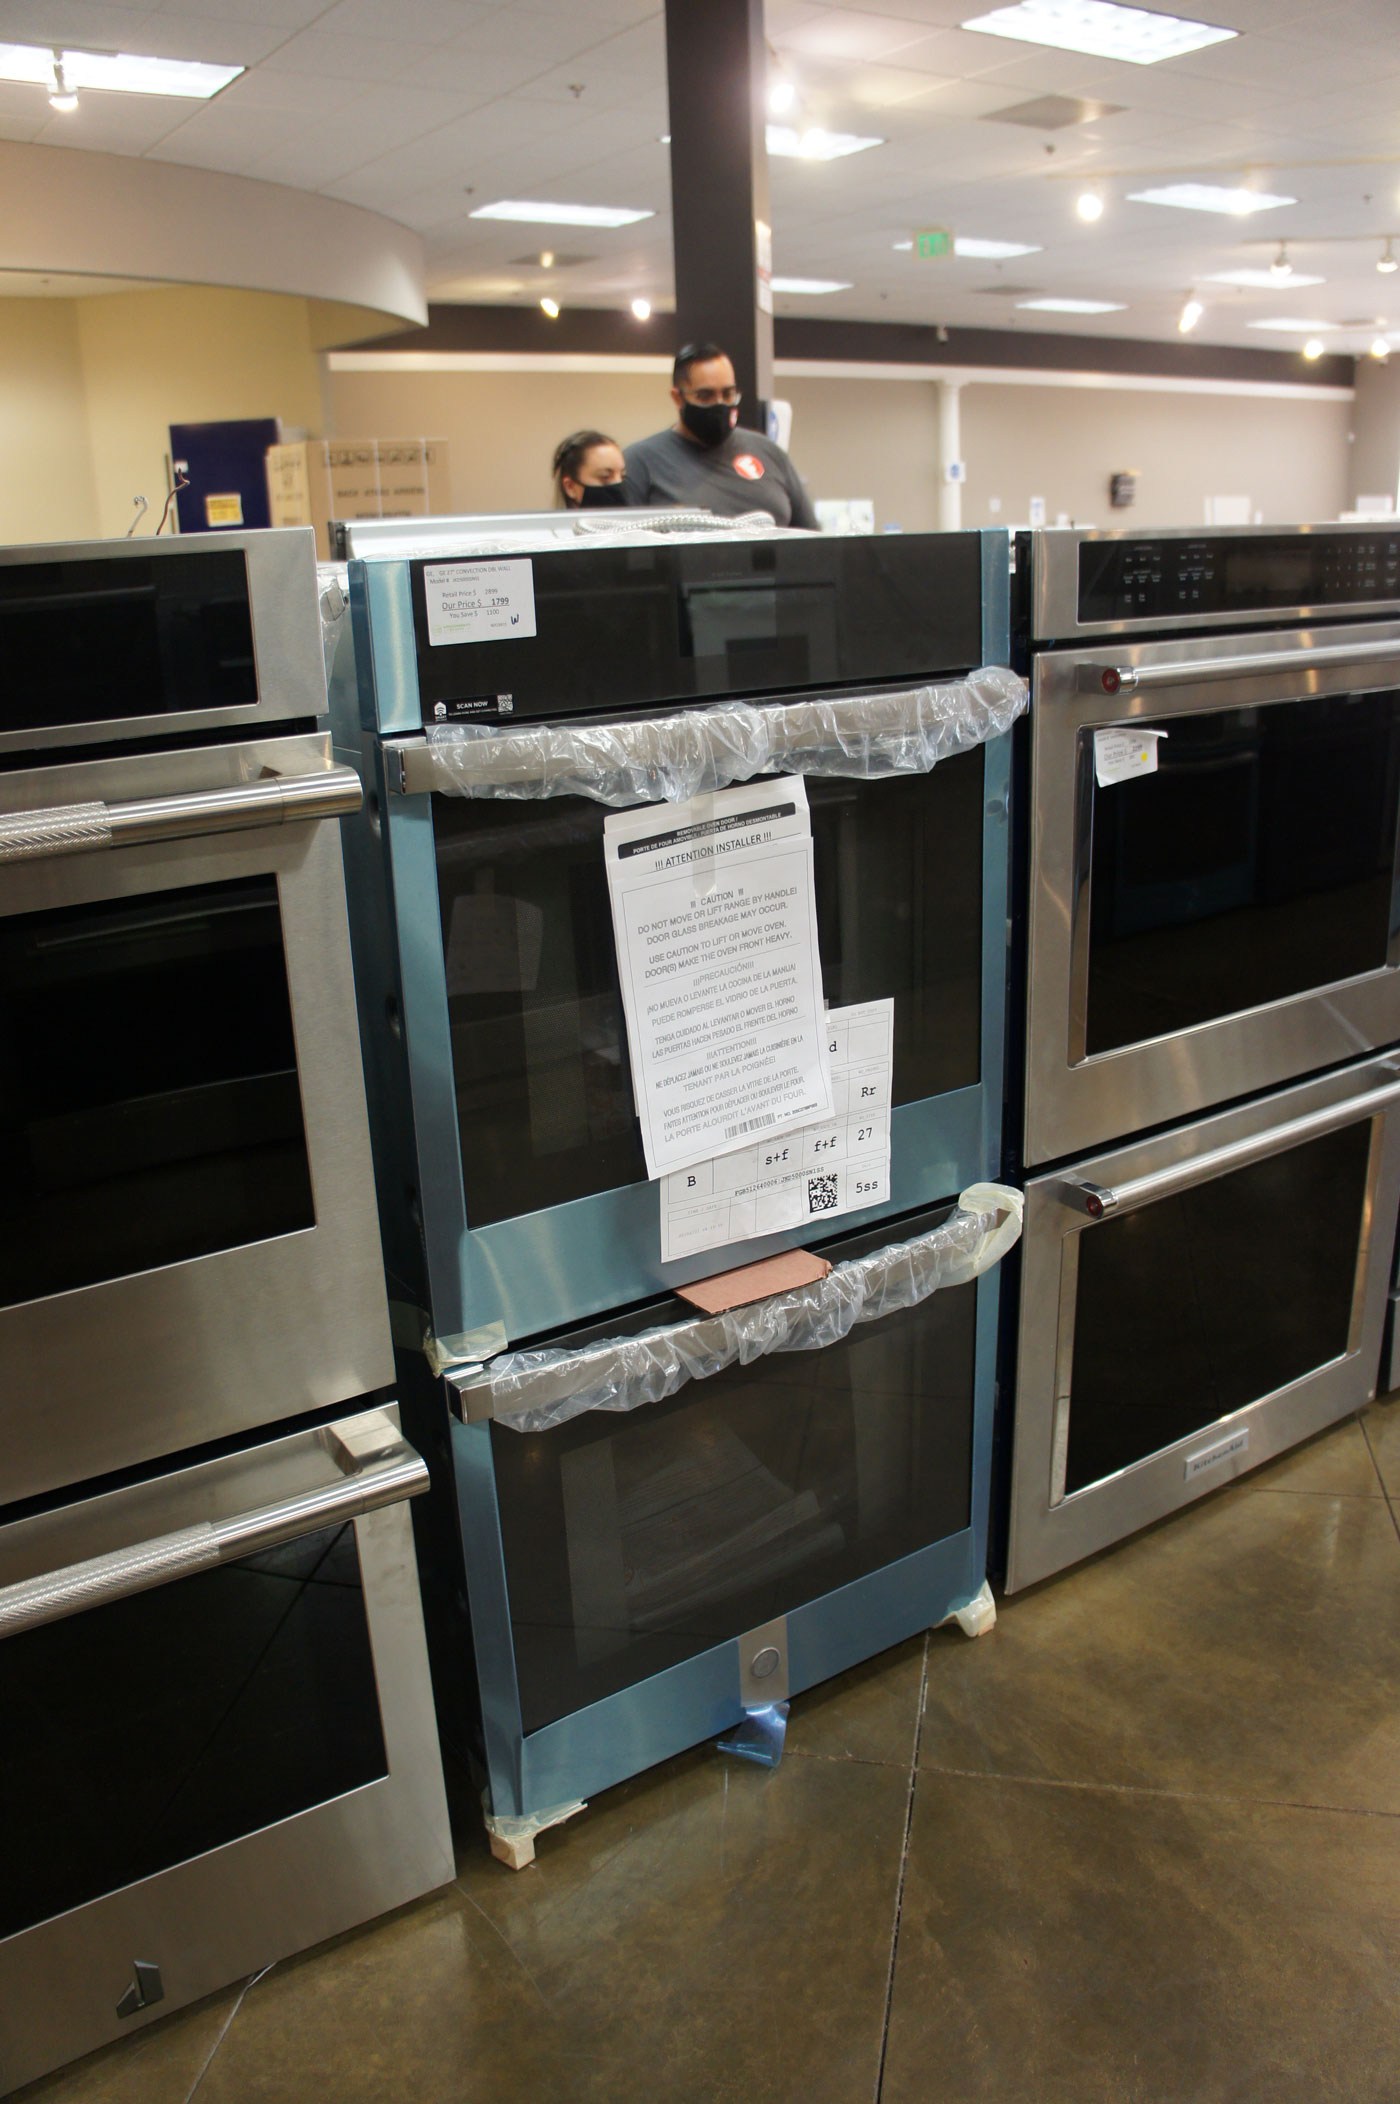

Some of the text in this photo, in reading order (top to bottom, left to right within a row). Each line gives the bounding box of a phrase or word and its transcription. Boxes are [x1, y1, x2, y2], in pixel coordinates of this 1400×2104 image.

[917, 233, 949, 258] EXIT
[442, 598, 510, 610] Our Price $ 1799
[511, 614, 520, 625] W
[456, 700, 489, 710] SCAN NOW
[633, 846, 650, 855] PORTE
[659, 839, 673, 847] FOUR
[728, 821, 745, 830] HORNO
[746, 812, 781, 826] DESMONTABLE
[721, 817, 735, 825] DOOR
[655, 831, 772, 871] !!! ATTENTION INSTALLER !!!
[638, 924, 650, 935] DO
[651, 920, 669, 931] NOT
[669, 913, 693, 926] MOVE
[693, 909, 706, 919] OR
[707, 905, 723, 916] LIFT
[724, 898, 751, 911] RANGE
[752, 895, 763, 904] BY
[700, 891, 734, 906] CAUTION
[647, 901, 788, 945] DOOR GLASS BREAKAGE MAY OCCUR.
[649, 920, 787, 965] USE CAUTION TO LIFT OR MOVE OVEN.
[644, 931, 792, 979] DOOR(S) MAKE THE OVEN FRONT HEAVY.
[652, 1013, 676, 1027] PUEDE
[676, 1001, 715, 1019] ROMPERSE
[715, 998, 724, 1007] EL
[725, 990, 748, 1004] VIDRIO
[749, 987, 759, 997] DE
[760, 985, 769, 994] LA
[660, 996, 683, 1010] MUEVA
[683, 994, 689, 1002] O
[689, 985, 718, 1001] LEVANTE
[719, 982, 728, 992] LA
[728, 975, 753, 989] COCINA
[753, 972, 762, 982] DE
[763, 970, 771, 979] LA
[652, 1006, 798, 1059] LAS PUERTAS HACEN PESADO EL FRENTE DEL HORNO
[655, 995, 795, 1046] TENGA CUIDADO AL LEVANTAR O MOVER EL HORNO
[655, 1080, 663, 1090] NE
[704, 1064, 712, 1073] OU
[712, 1062, 719, 1071] NE
[760, 1047, 765, 1055] LA
[791, 1036, 797, 1045] EN
[797, 1034, 804, 1042] LA
[683, 1076, 713, 1092] TENANT
[714, 1071, 730, 1082] PAR
[731, 1067, 741, 1077] LA
[663, 1106, 680, 1118] VOUS
[680, 1097, 706, 1112] RISQUEZ
[706, 1094, 715, 1104] DE
[715, 1086, 738, 1100] CASSER
[739, 1084, 746, 1092] LA
[746, 1078, 763, 1090] VITRE
[763, 1075, 771, 1084] DE
[772, 1072, 779, 1081] LA
[663, 1118, 682, 1131] FAITES
[682, 1108, 710, 1124] ATTENTION
[710, 1103, 724, 1115] POUR
[750, 1092, 758, 1100] OU
[759, 1083, 784, 1098] SOULEVER
[784, 1080, 790, 1089] LE
[861, 1084, 877, 1098] Rr
[664, 1133, 675, 1143] LA
[676, 1123, 701, 1139] PORTE
[702, 1110, 739, 1130] ALOURDIT
[740, 1100, 770, 1116] L'AVANT
[771, 1095, 782, 1105] DU
[858, 1127, 873, 1141] 27
[765, 1148, 789, 1165] s+f
[814, 1135, 837, 1152] f+f
[687, 1174, 697, 1188] B
[855, 1177, 879, 1194] 5ss
